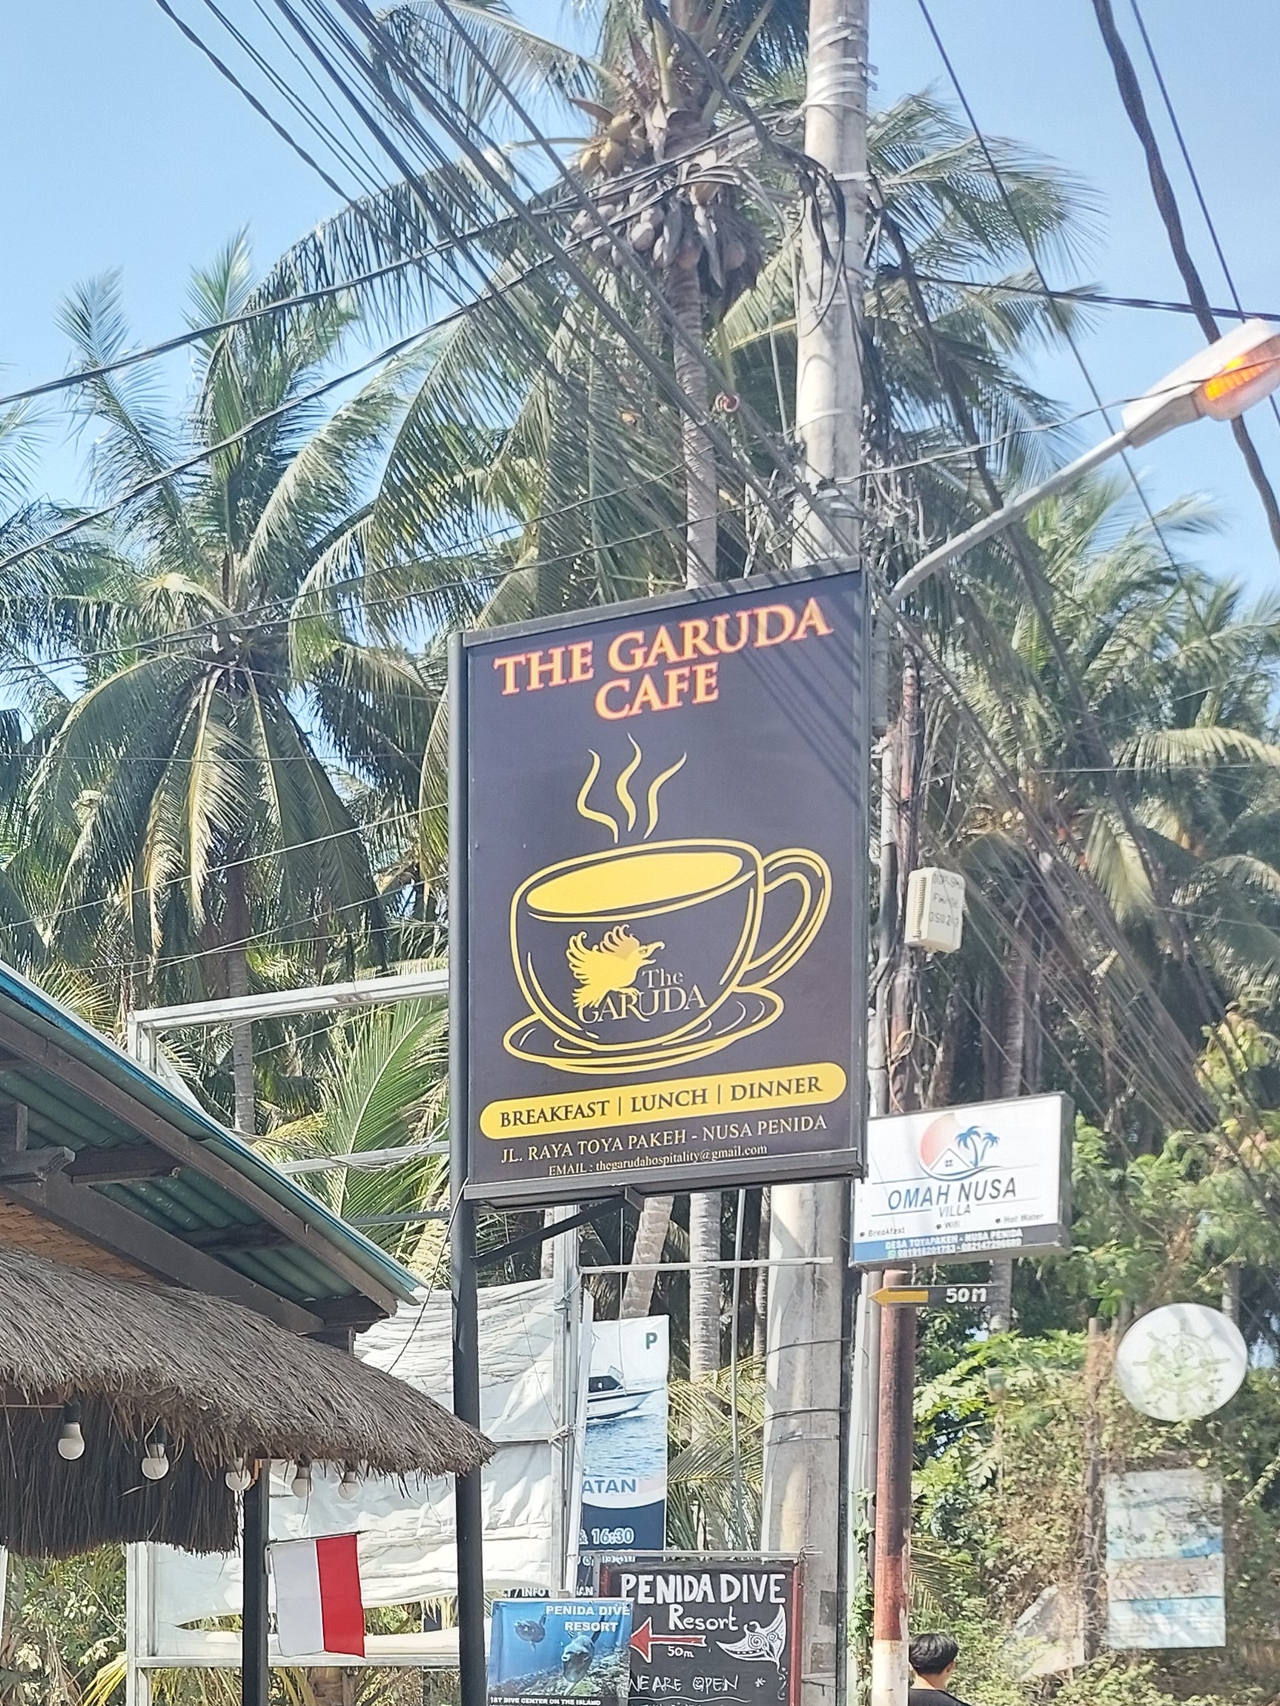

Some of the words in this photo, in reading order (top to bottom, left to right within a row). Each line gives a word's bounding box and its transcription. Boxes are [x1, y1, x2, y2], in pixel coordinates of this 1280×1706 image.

[493, 641, 595, 695] THE
[608, 597, 834, 673] GARUDA
[594, 662, 720, 721] CAFE
[641, 968, 684, 989] The
[577, 984, 708, 1024] GARUDA
[500, 1100, 610, 1128] BREAKFAST
[630, 1088, 708, 1113] LUNCH
[730, 1075, 823, 1101] DINNER
[501, 1147, 523, 1164] JL.
[527, 1141, 573, 1162] RAYA
[577, 1136, 624, 1157] TOYA
[628, 1129, 686, 1149] PAKEH
[703, 1123, 752, 1143] NUSA
[757, 1114, 828, 1136] PENIDA
[548, 1162, 587, 1177] EMAIL
[888, 1184, 951, 1210] OMAH
[958, 1177, 1017, 1203] NUSA
[938, 1204, 971, 1218] VILLA
[621, 1573, 715, 1605] PENIDA
[720, 1573, 787, 1604] DIVE
[545, 1604, 595, 1617] PENIDA
[598, 1605, 631, 1617] DIVE
[669, 1604, 739, 1632] Resort
[564, 1621, 618, 1633] RESORT
[667, 1646, 695, 1660] 50m
